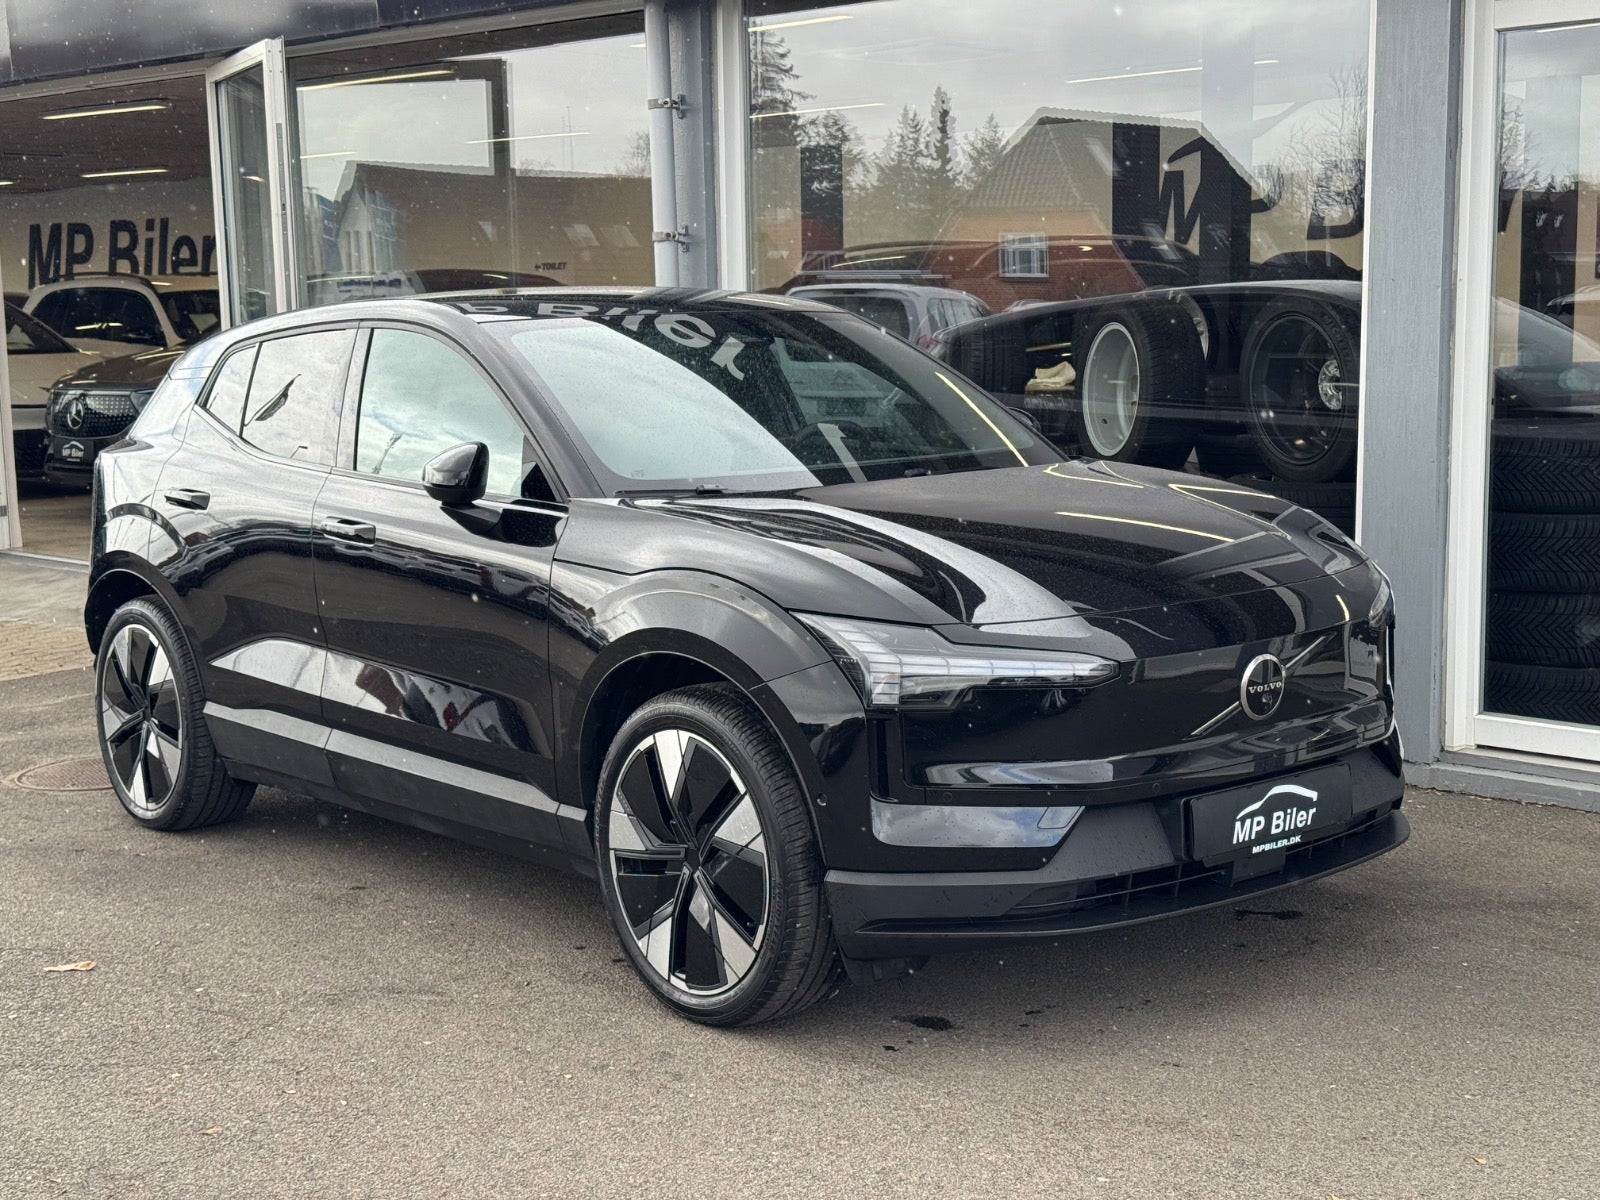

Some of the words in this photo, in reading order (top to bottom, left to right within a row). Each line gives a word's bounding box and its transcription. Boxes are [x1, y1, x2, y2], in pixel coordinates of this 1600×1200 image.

[28, 222, 95, 290] MP
[108, 217, 216, 277] Biler
[541, 262, 567, 271] TOILET
[1248, 681, 1282, 694] VOLVO
[1232, 815, 1265, 845] MP
[1270, 807, 1317, 835] Biler
[1251, 834, 1302, 854] MPBILER.DK
